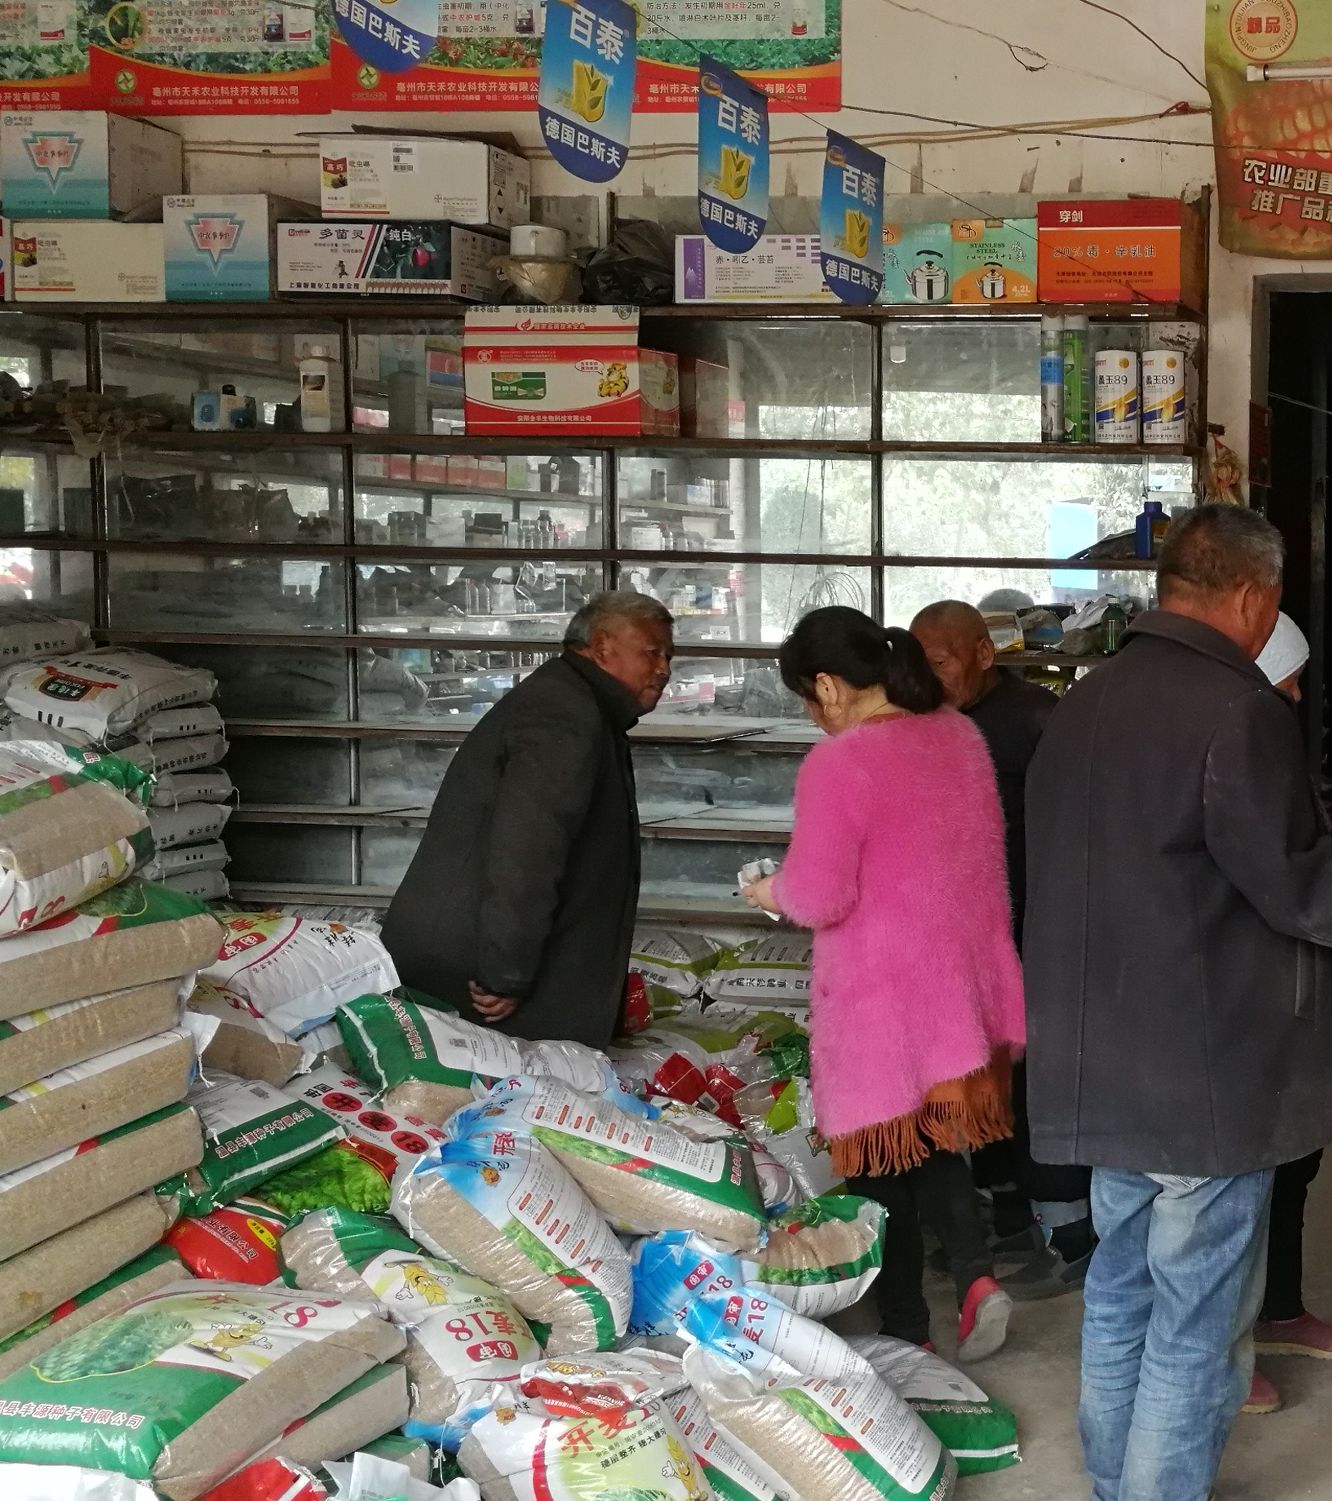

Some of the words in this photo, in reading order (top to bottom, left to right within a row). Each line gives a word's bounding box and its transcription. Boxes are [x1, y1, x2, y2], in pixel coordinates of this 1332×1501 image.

[335, 0, 421, 59] 德国巴斯夫
[569, 6, 626, 65] 百泰
[152, 85, 299, 97] 亳州市天禾农业科技开发有限公司
[396, 81, 539, 92] 亳州市天禾农业科技开发有限公
[718, 101, 761, 146] 百泰
[545, 116, 622, 170] 德国巴斯夫
[842, 166, 878, 208] 百泰
[319, 228, 366, 241] 多菌灵
[701, 197, 760, 240] 德国巴斯夫
[1059, 210, 1083, 223] 穿剑
[389, 229, 412, 242] 纯白
[826, 257, 879, 294] 德国巴斯夫
[0, 1400, 146, 1430] 县丰源种子有限公司
